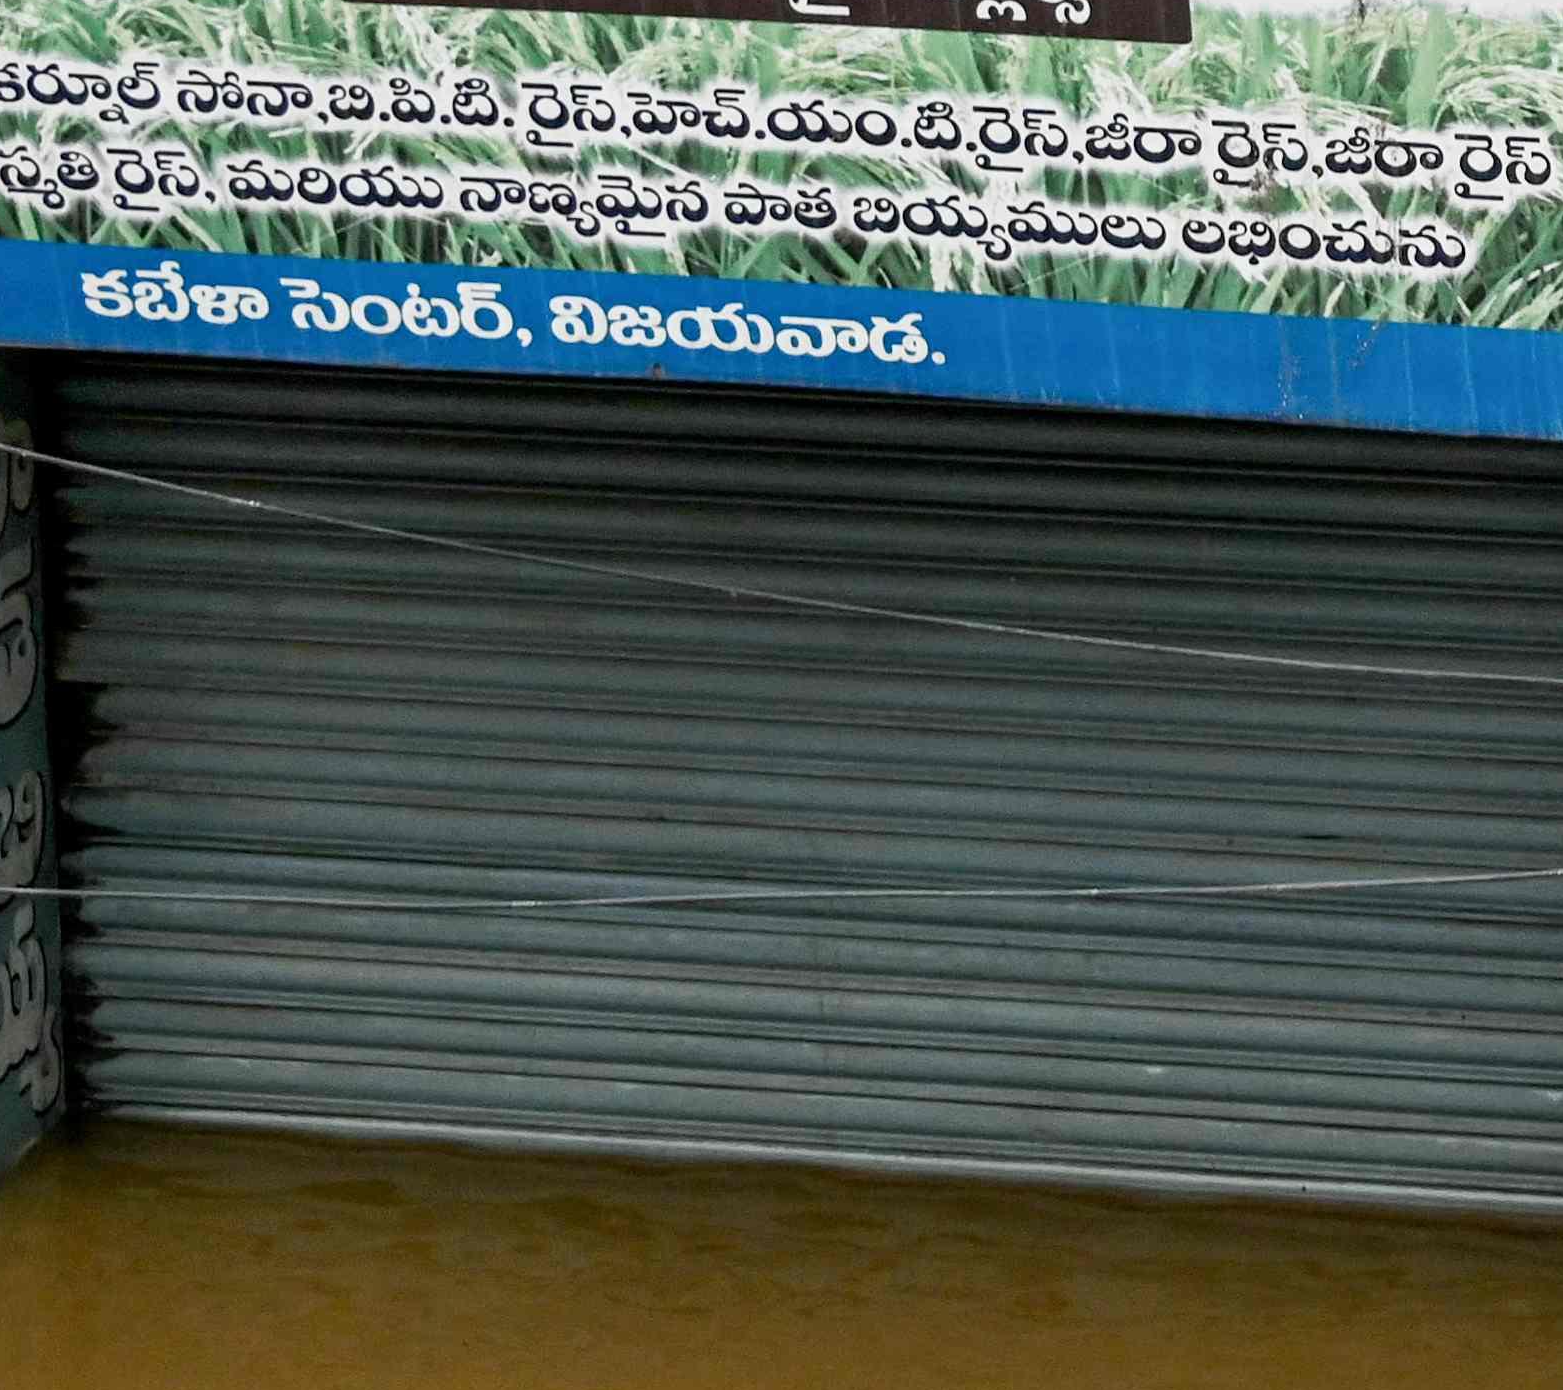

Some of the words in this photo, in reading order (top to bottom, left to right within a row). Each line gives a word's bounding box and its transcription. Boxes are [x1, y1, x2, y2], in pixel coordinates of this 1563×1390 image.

[226, 159, 445, 210] మరియు
[459, 173, 711, 237] నాణ్యమైన
[723, 181, 839, 230] పాత
[852, 191, 1168, 262] బియ్యములు
[1180, 211, 1468, 269] లభించును
[1453, 131, 1554, 202] రైస్
[79, 262, 272, 323] కబేళా
[277, 276, 535, 348] సెంటర్,
[548, 294, 949, 368] విజయవాడ.
